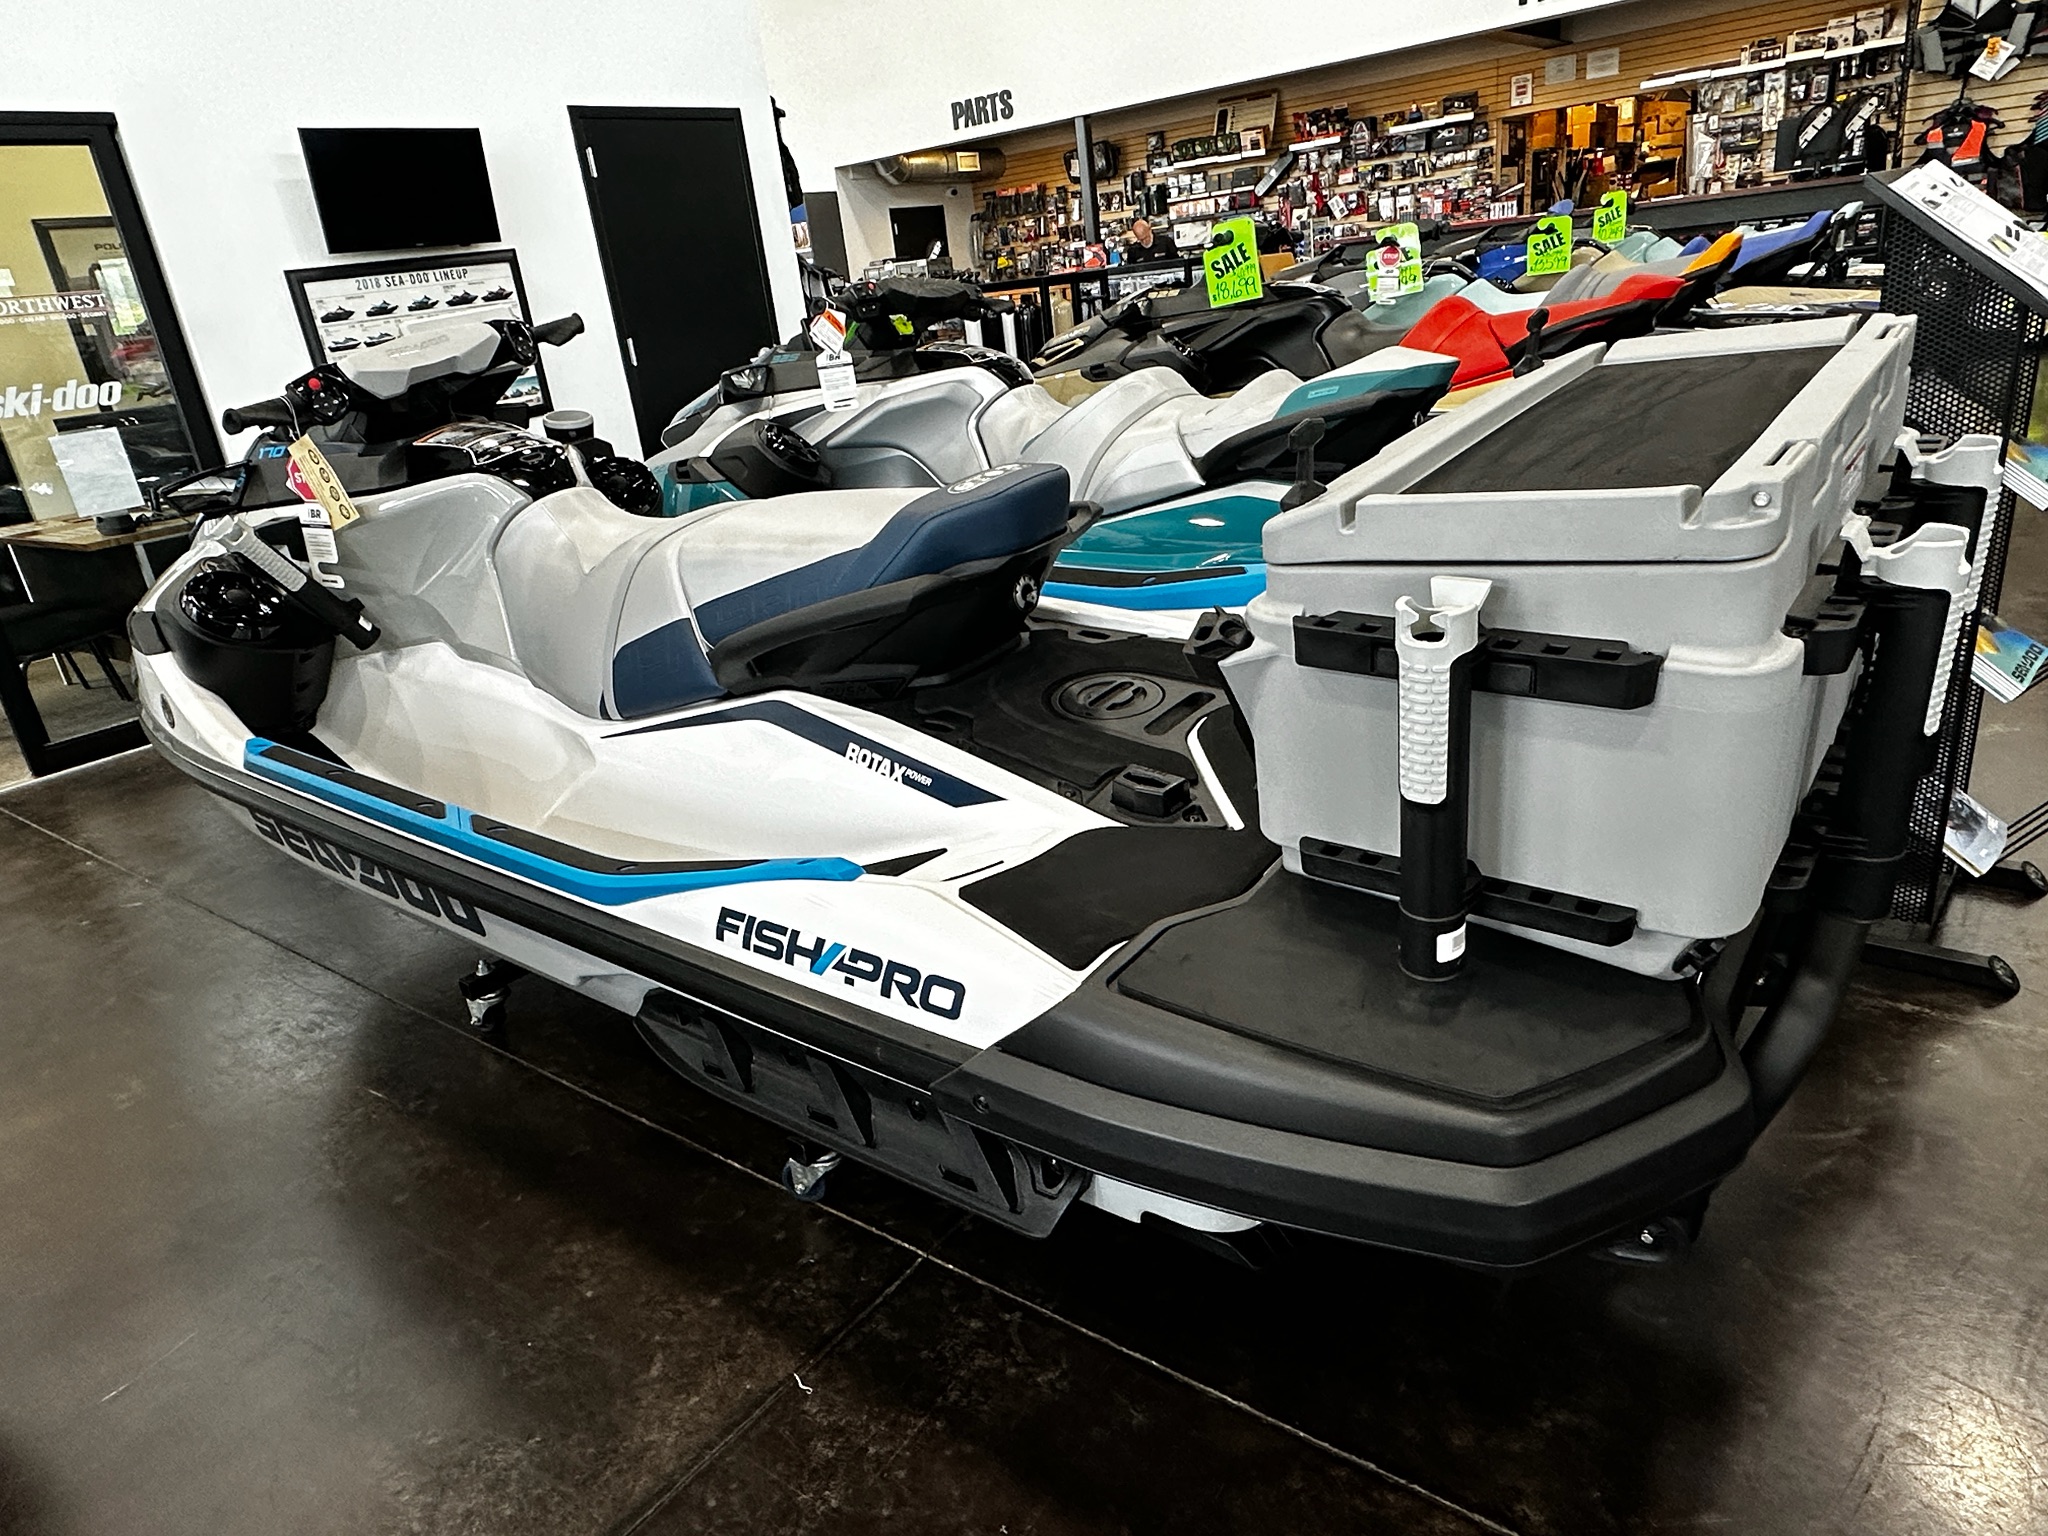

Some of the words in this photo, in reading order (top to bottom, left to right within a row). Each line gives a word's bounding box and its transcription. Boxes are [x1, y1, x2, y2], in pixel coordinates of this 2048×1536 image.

[951, 90, 1014, 131] PARTS
[1597, 205, 1622, 228] SALE
[1532, 232, 1566, 256] SALE
[1210, 242, 1251, 279] SALE
[355, 278, 382, 291] 2018
[384, 271, 431, 288] SEA-DOO
[432, 268, 468, 282] LINEUP
[258, 445, 287, 460] 170
[844, 741, 907, 785] ROTAX
[903, 766, 933, 788] POWER
